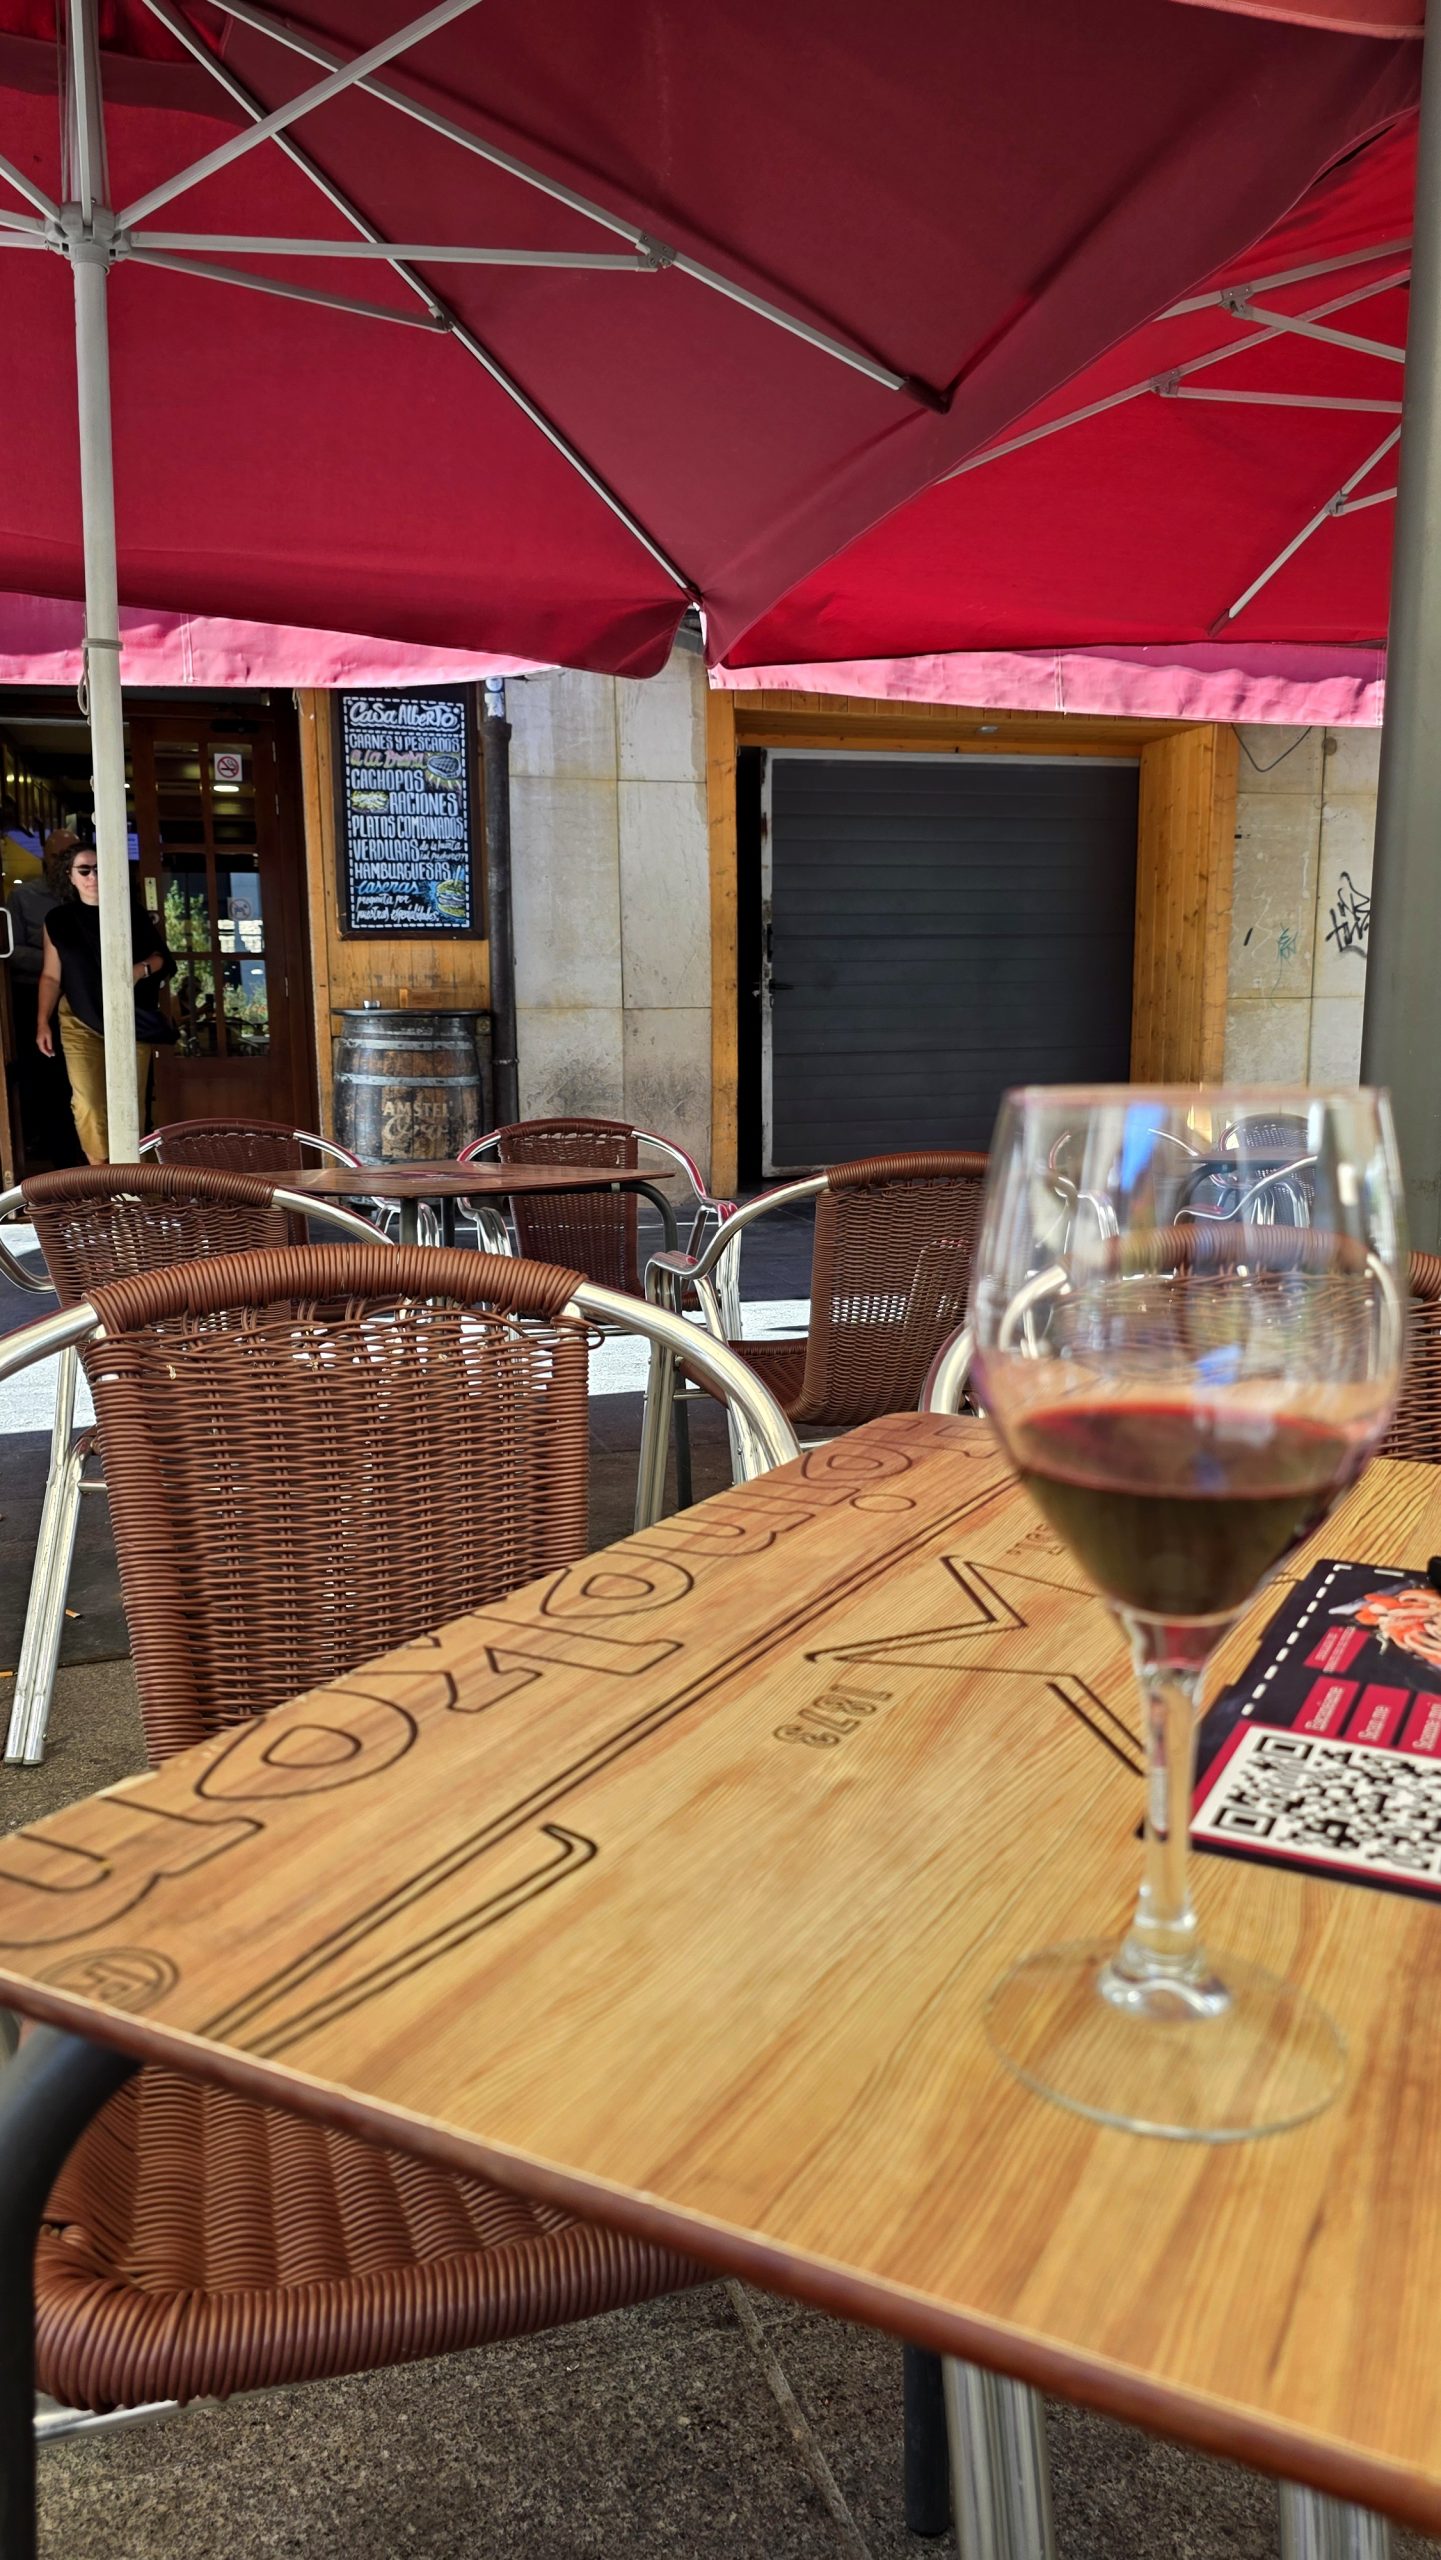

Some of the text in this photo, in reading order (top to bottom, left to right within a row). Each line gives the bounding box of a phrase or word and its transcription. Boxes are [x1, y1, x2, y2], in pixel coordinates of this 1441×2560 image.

[349, 733, 460, 752] CARNES Y PESCADOS
[363, 749, 383, 767] la
[351, 768, 425, 792] CACHOPOS
[389, 792, 459, 817] RACIONES
[351, 815, 464, 840] PLATOS COMBINADOS
[353, 839, 420, 862] VERDURAS
[354, 862, 451, 881] HAMBURGUESAS
[382, 1101, 449, 1117] AMSTEL
[773, 1684, 894, 1749] 1873
